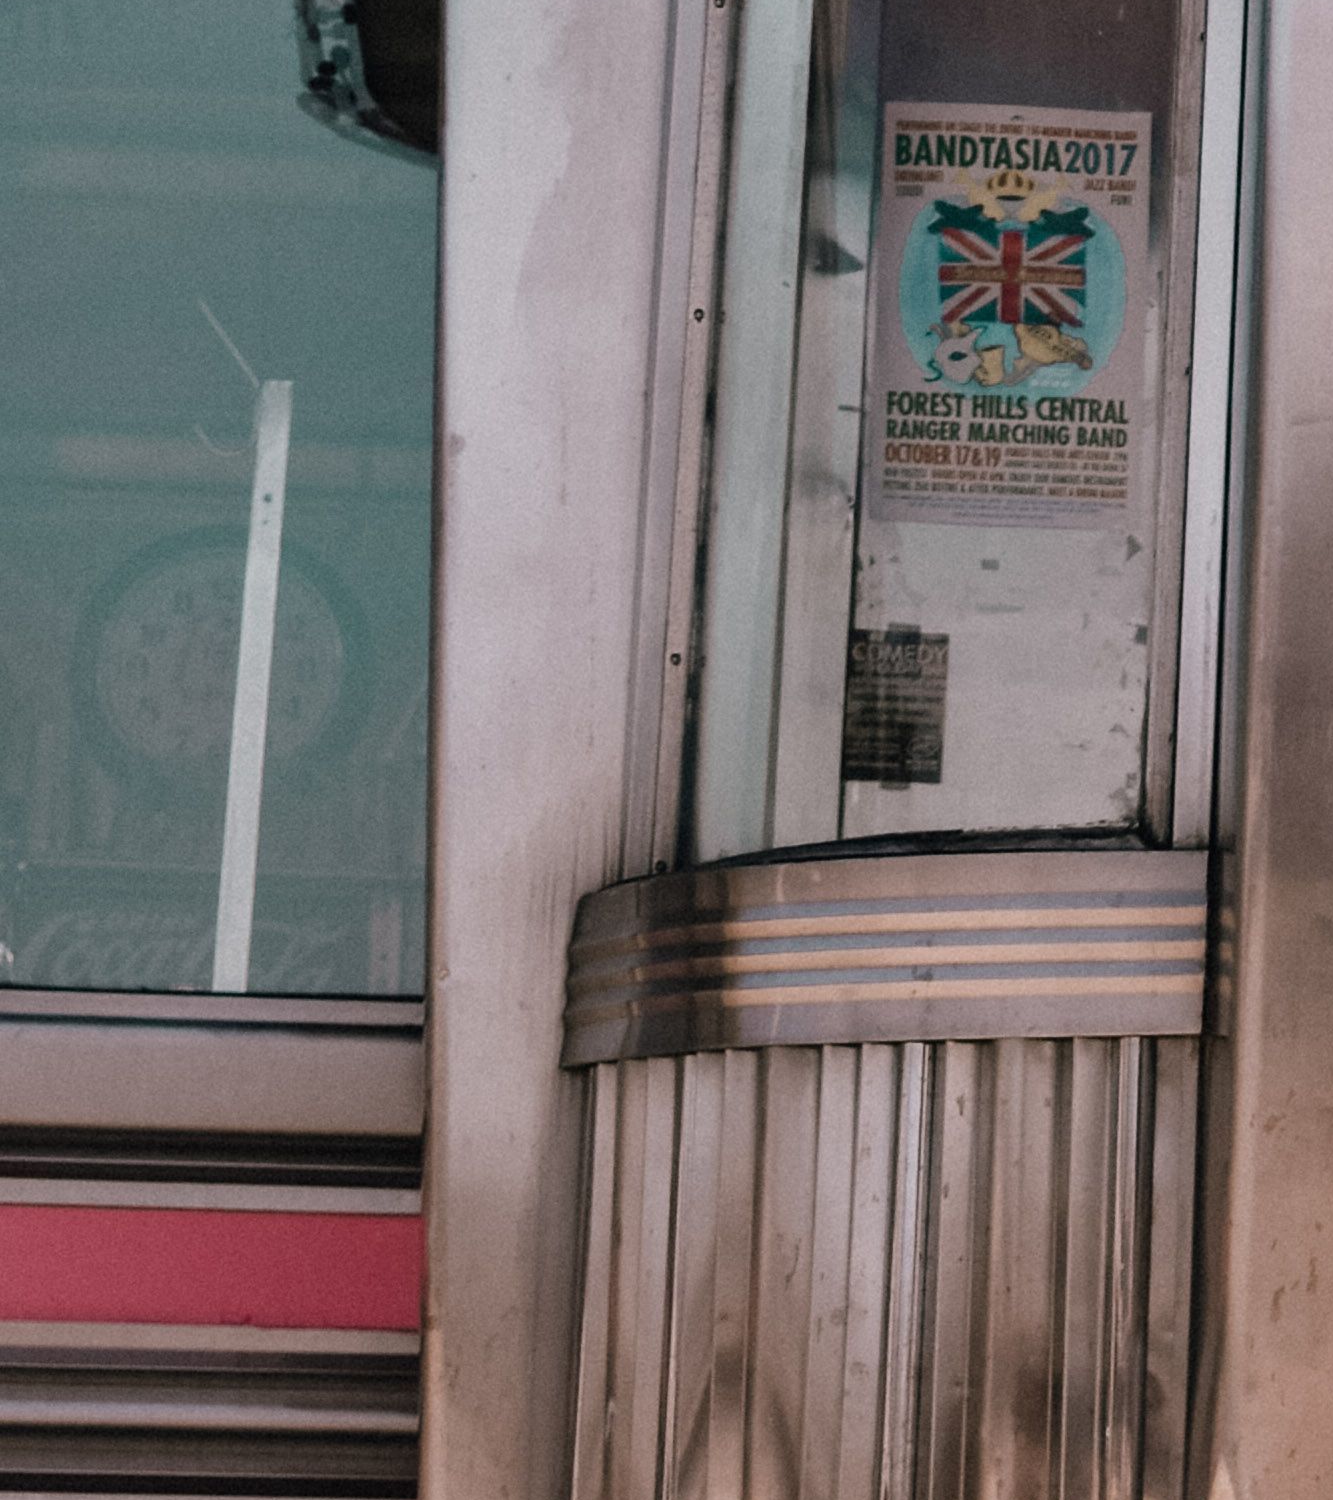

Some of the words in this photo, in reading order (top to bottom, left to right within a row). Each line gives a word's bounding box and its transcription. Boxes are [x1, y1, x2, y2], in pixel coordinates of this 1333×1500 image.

[886, 391, 965, 417] FOREST
[972, 394, 1028, 420] HILLS
[1035, 396, 1129, 424] CENTRAL
[886, 419, 960, 441] RANGER
[967, 421, 1070, 446] MARCHING
[1076, 425, 1128, 448] BAND
[884, 443, 951, 466] OCTOBER
